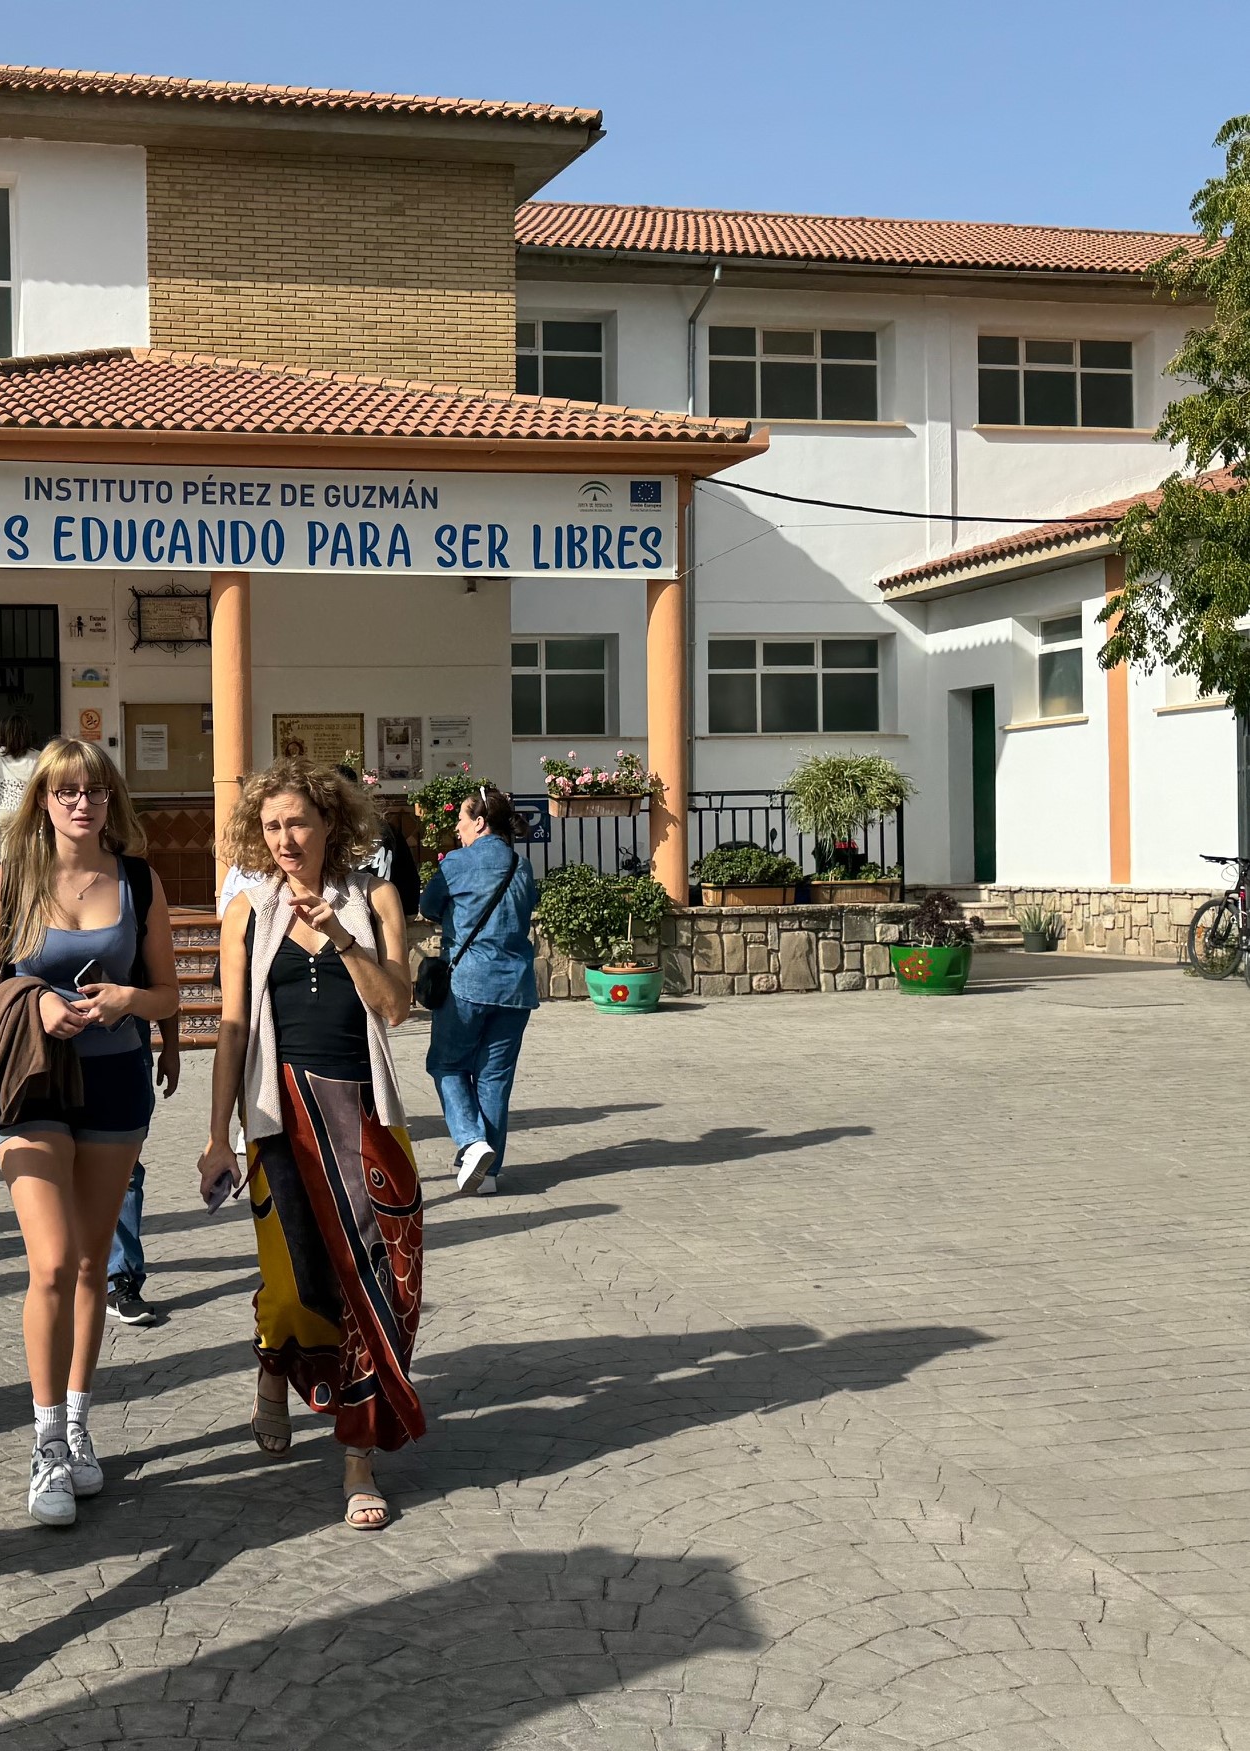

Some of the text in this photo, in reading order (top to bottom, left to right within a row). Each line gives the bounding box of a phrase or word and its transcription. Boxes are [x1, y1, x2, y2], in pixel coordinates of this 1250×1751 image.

[24, 474, 438, 510] INSTITUTO PÉREZ DE GUZMÁN
[53, 515, 285, 566] EDUCANDO
[307, 520, 412, 568] PARA
[434, 523, 511, 569] SER
[532, 523, 663, 570] LIBRES
